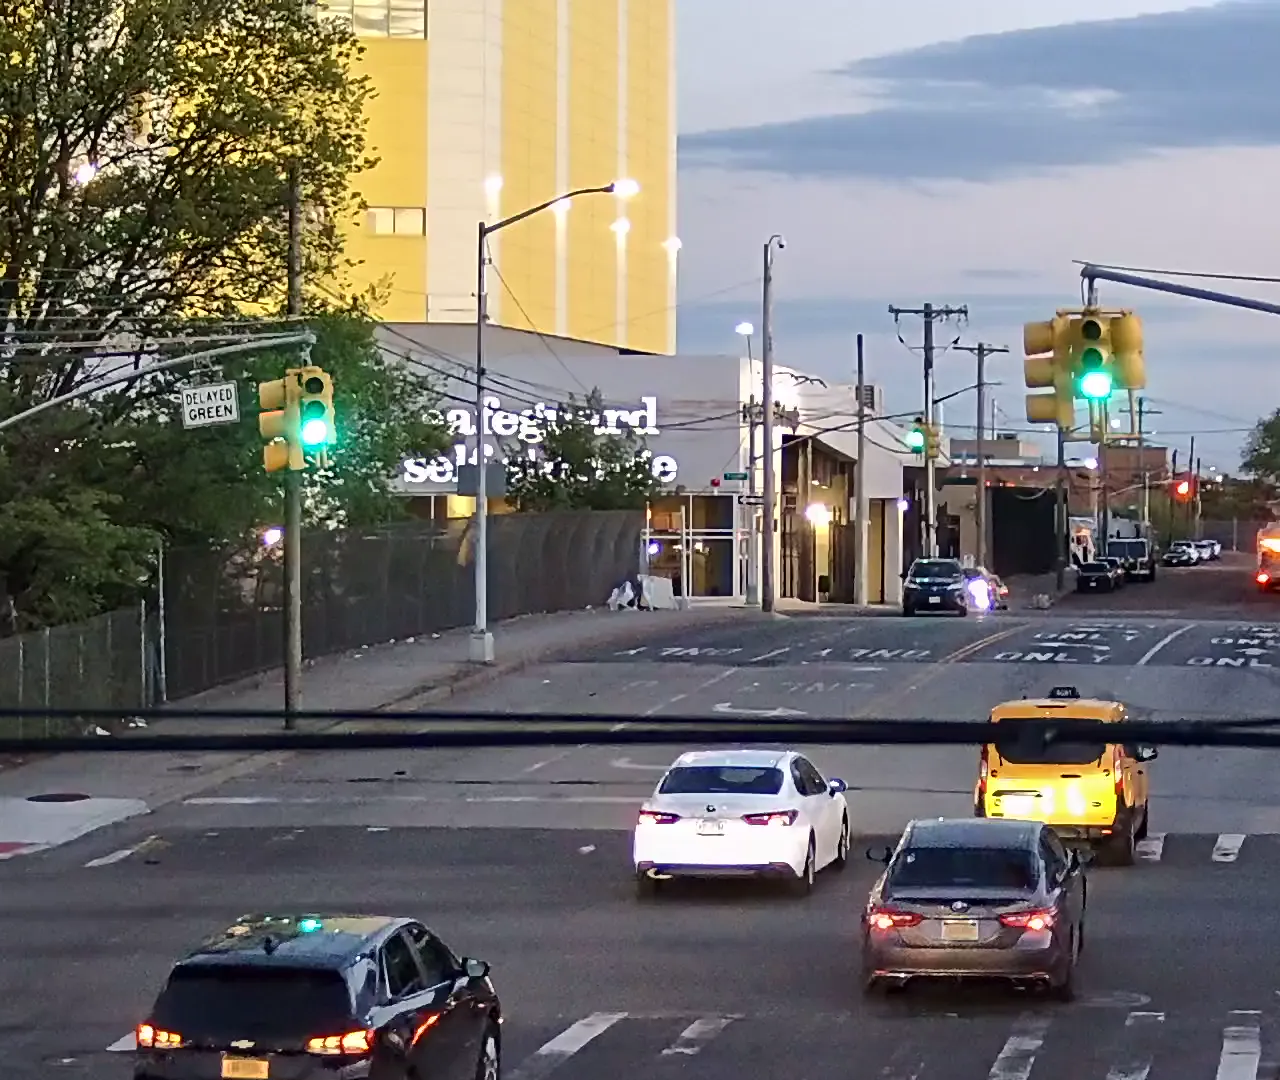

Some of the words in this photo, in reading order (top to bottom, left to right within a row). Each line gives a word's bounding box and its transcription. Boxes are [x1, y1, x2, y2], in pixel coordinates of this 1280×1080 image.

[186, 388, 233, 406] DELAYED
[189, 404, 233, 421] GREEN
[993, 651, 1112, 663] ONLY
